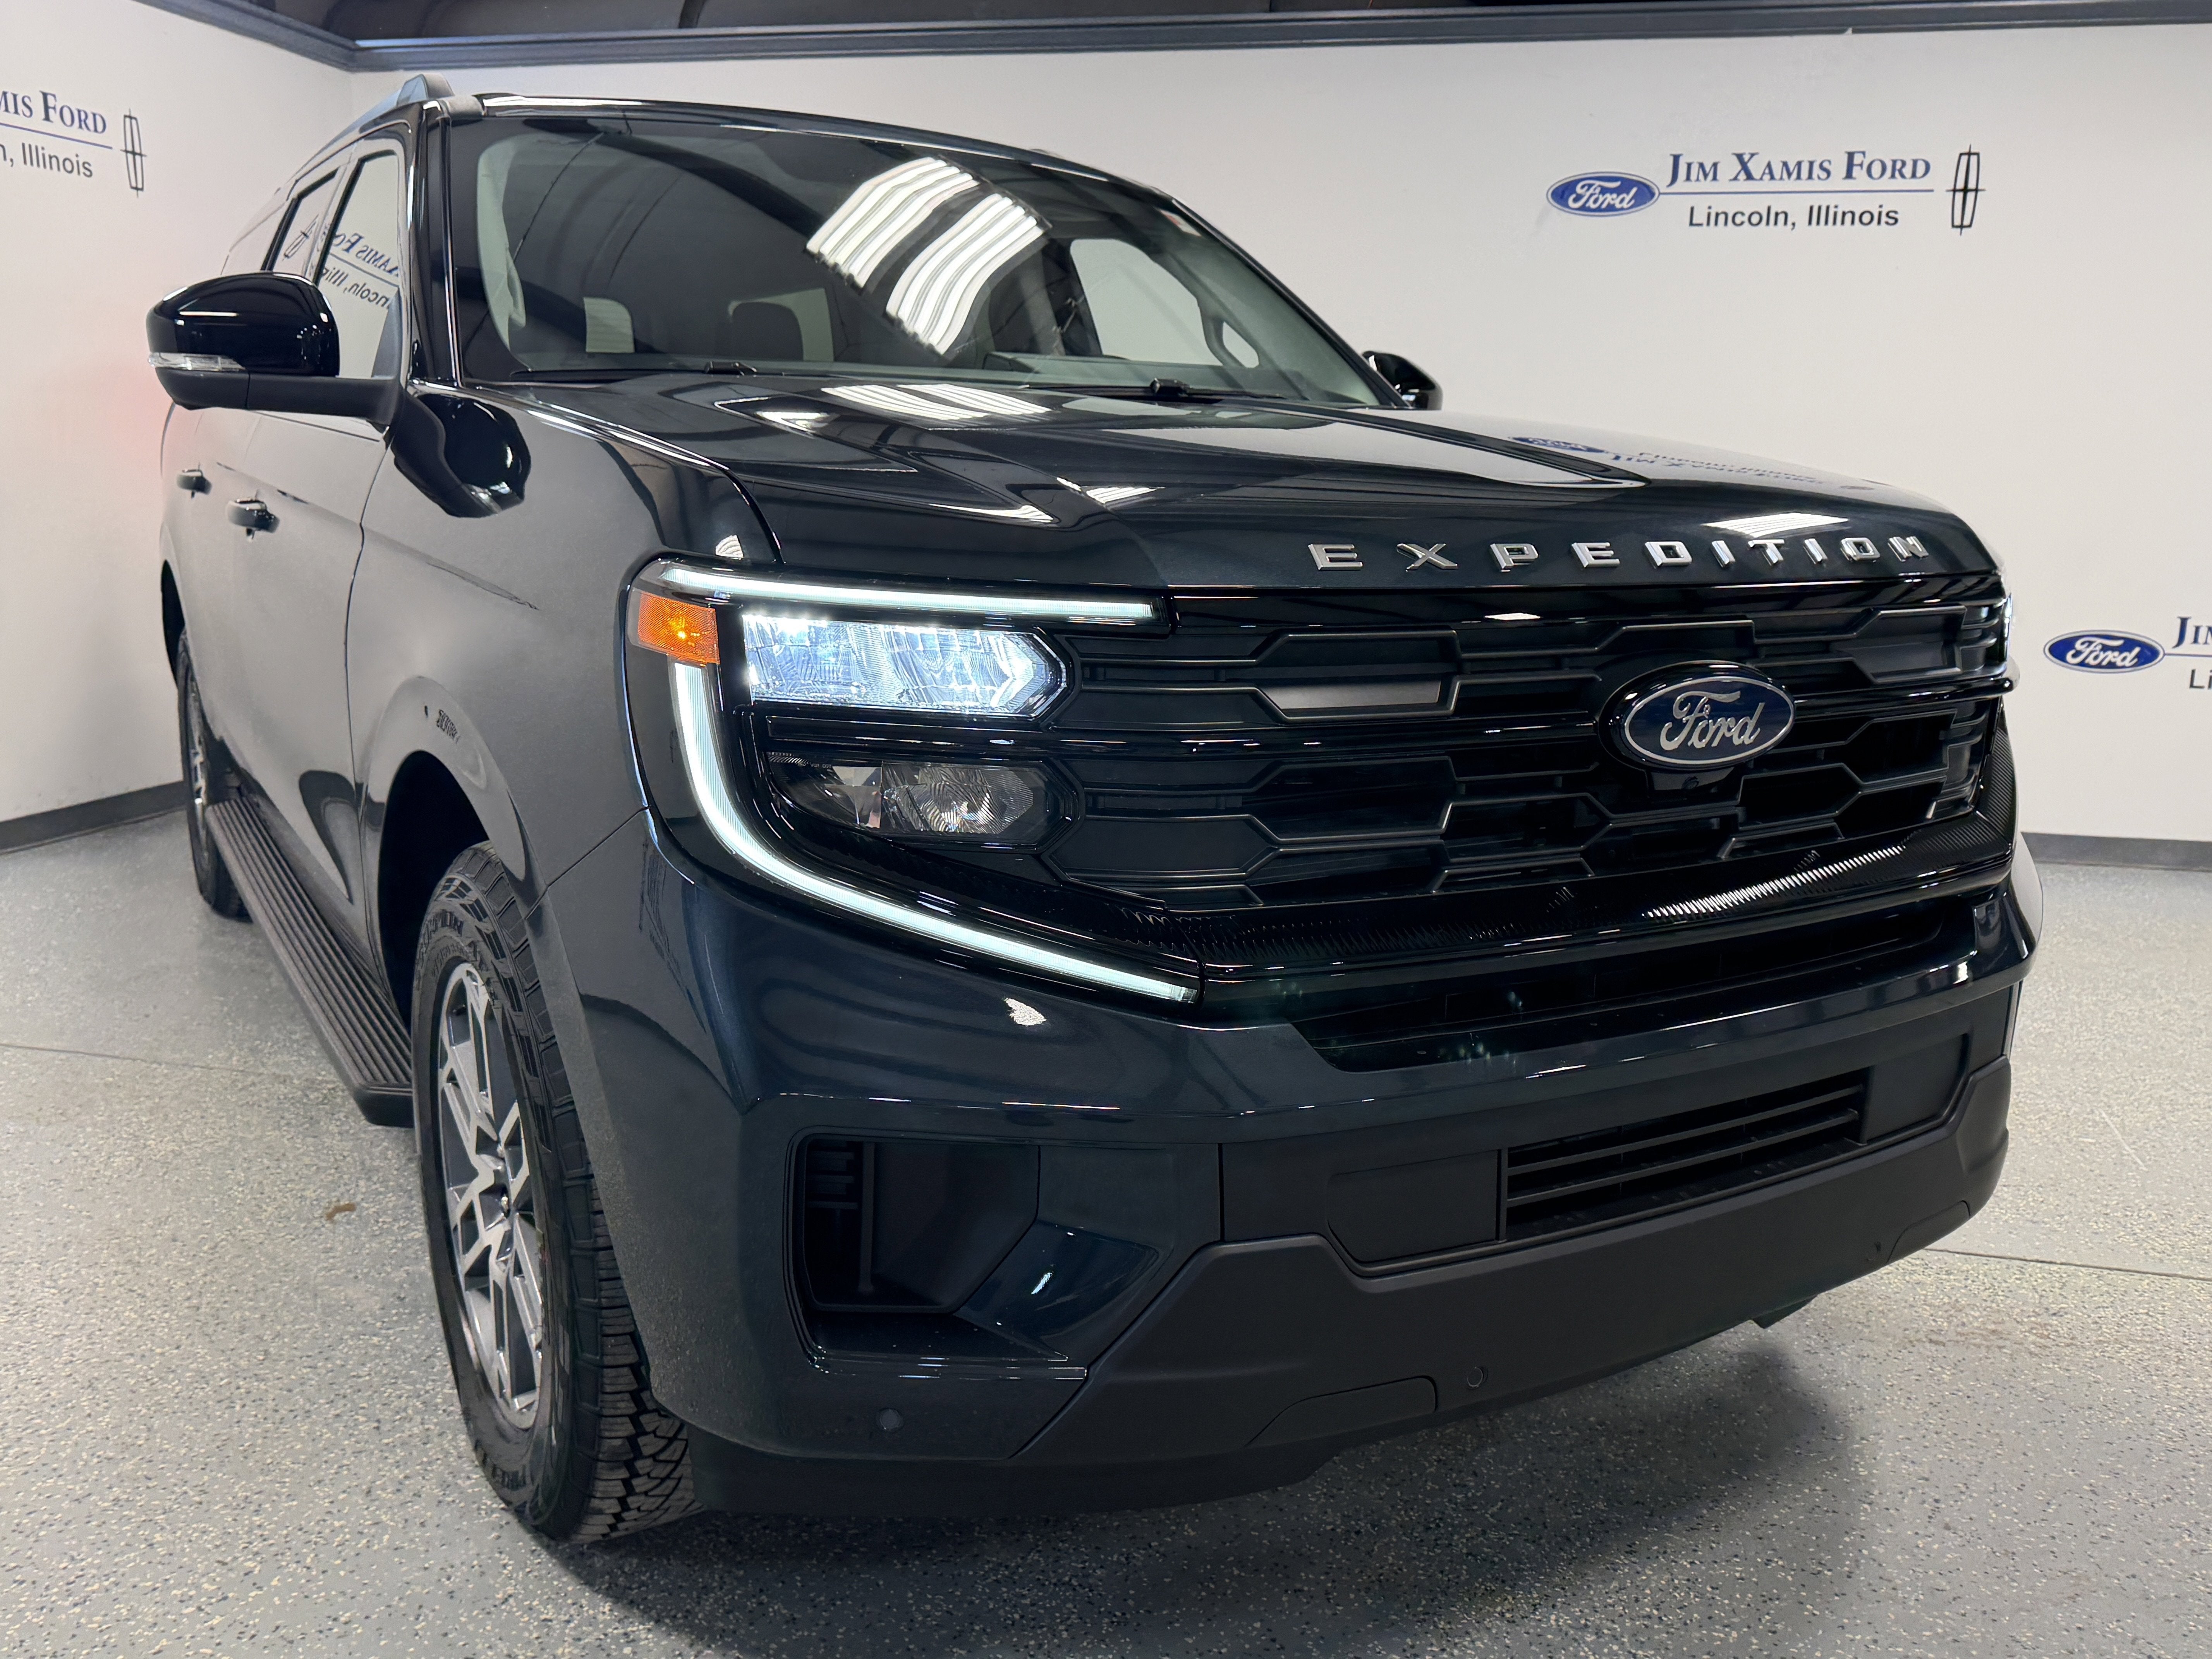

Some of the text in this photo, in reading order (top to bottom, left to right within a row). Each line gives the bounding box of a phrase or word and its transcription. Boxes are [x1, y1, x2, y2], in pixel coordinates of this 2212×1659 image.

[39, 90, 106, 134] FORD
[22, 142, 93, 178] Illinois
[1666, 150, 1931, 188] JIM XAMIS FORD
[1567, 179, 1638, 210] Ford
[1688, 204, 1899, 231] Lincoln, Illinois
[1308, 536, 1930, 572] EXPEDITION
[2066, 637, 2141, 667] Ford
[1660, 690, 1765, 750] Ford
